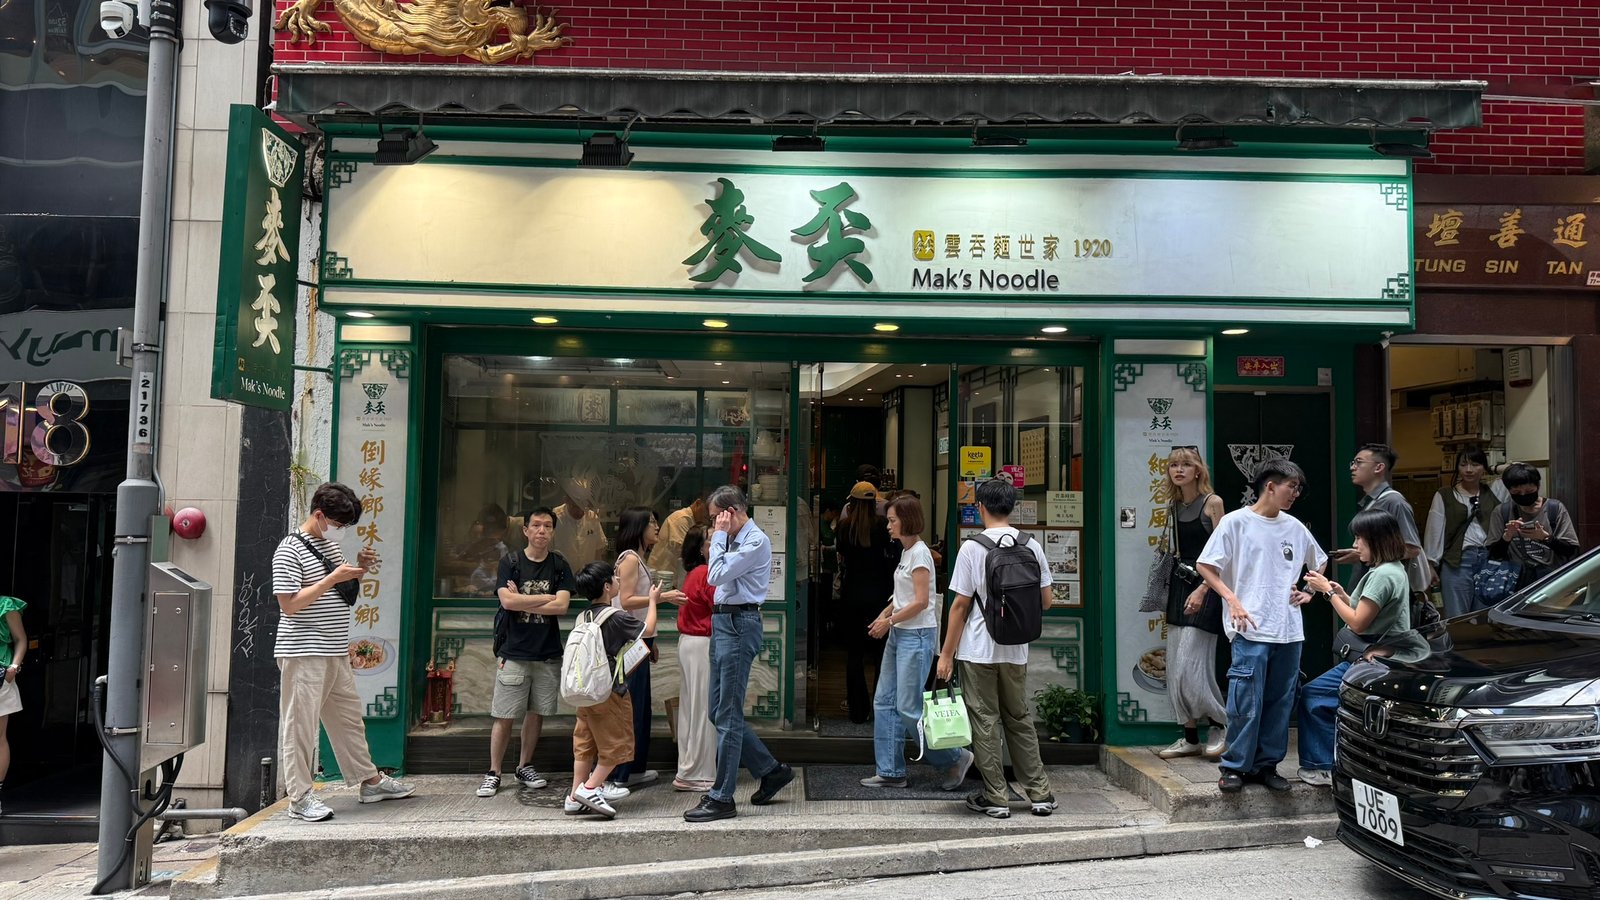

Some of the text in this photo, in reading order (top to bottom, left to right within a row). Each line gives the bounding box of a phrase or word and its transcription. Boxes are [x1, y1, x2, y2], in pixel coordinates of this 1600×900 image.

[682, 177, 874, 284] 麥奀
[1074, 238, 1112, 258] 1920
[912, 267, 1060, 290] Mak's Noodle
[1414, 259, 1584, 275] TUNG SIN TAN
[241, 377, 286, 400] Mak's Noodle
[138, 378, 151, 438] 21736
[1364, 785, 1386, 814] UE
[1358, 802, 1398, 840] 7009
